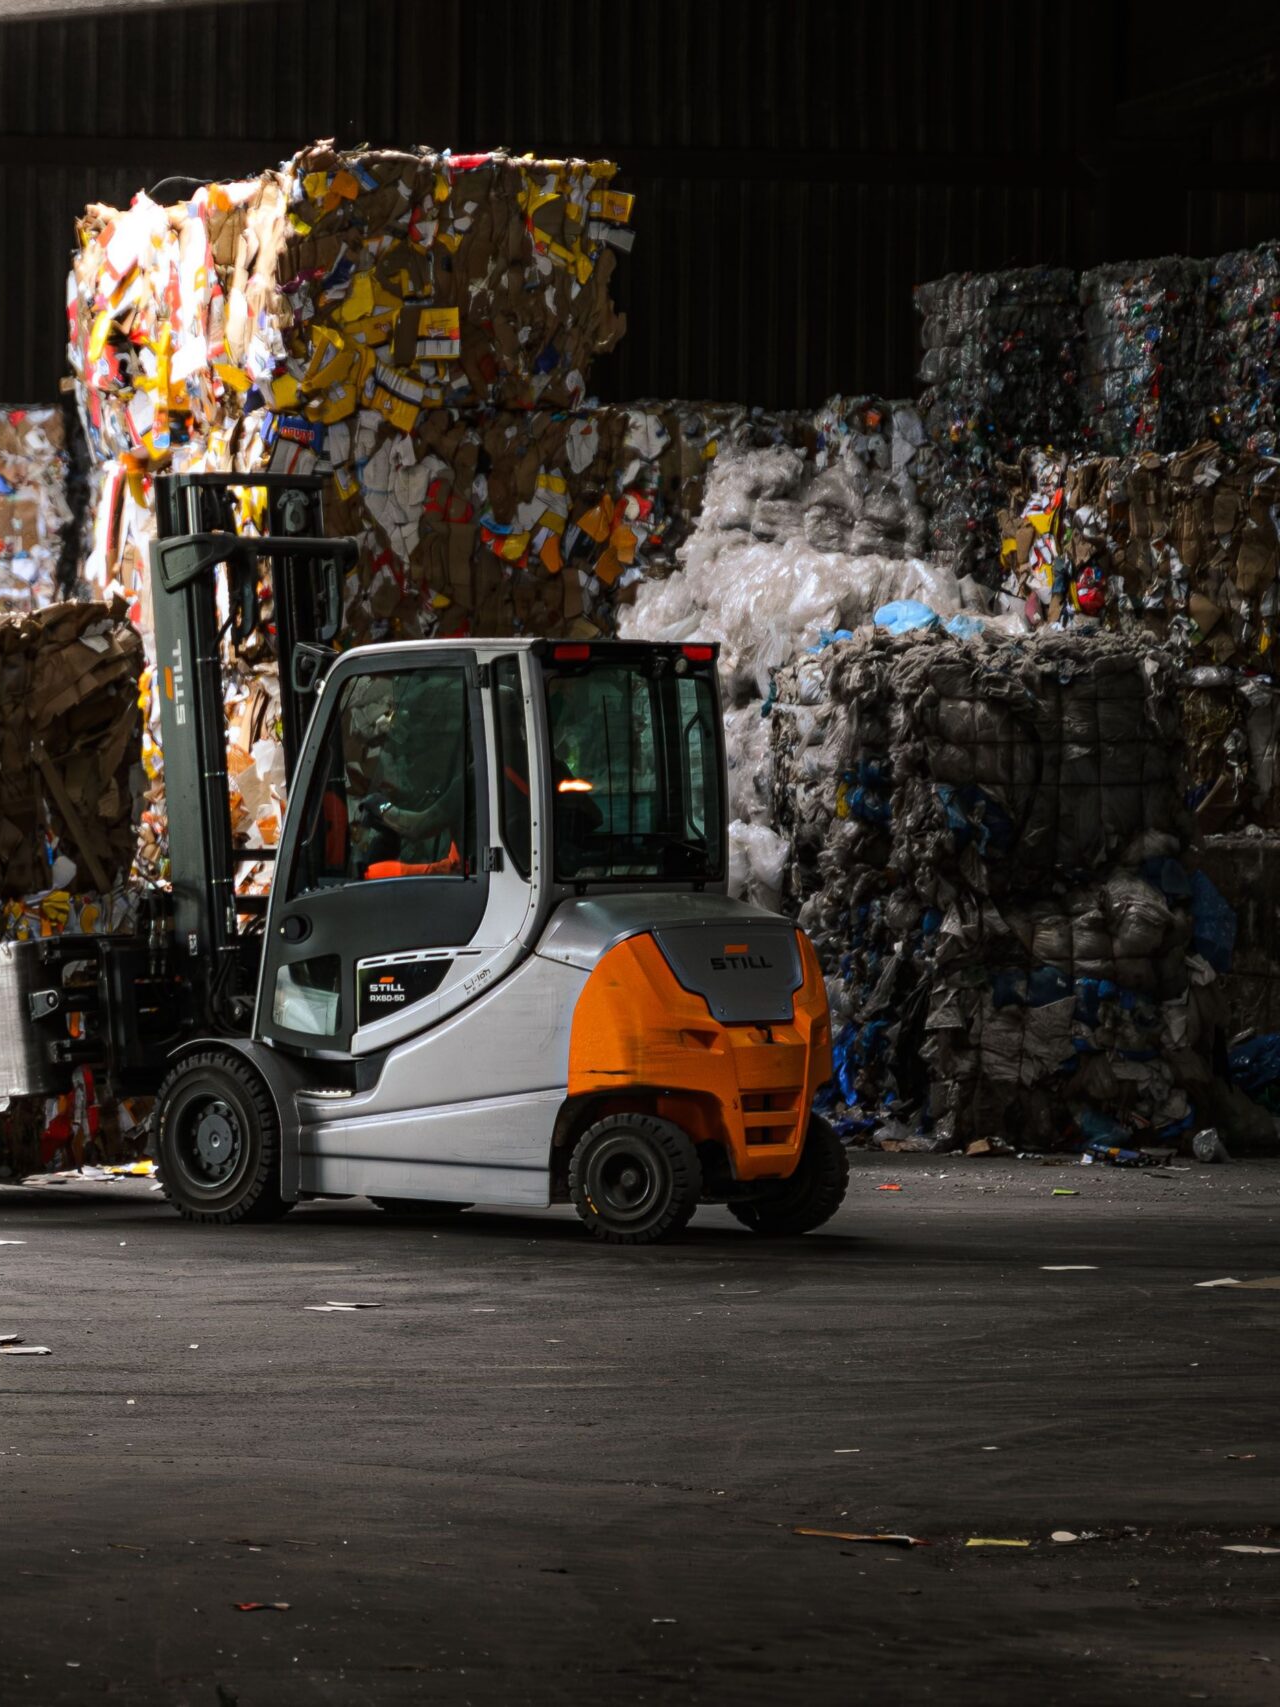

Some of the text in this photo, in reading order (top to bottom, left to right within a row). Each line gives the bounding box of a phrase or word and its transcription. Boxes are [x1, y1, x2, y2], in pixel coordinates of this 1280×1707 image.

[172, 638, 186, 726] STILL
[710, 955, 773, 970] STILL
[369, 983, 405, 992] STILL
